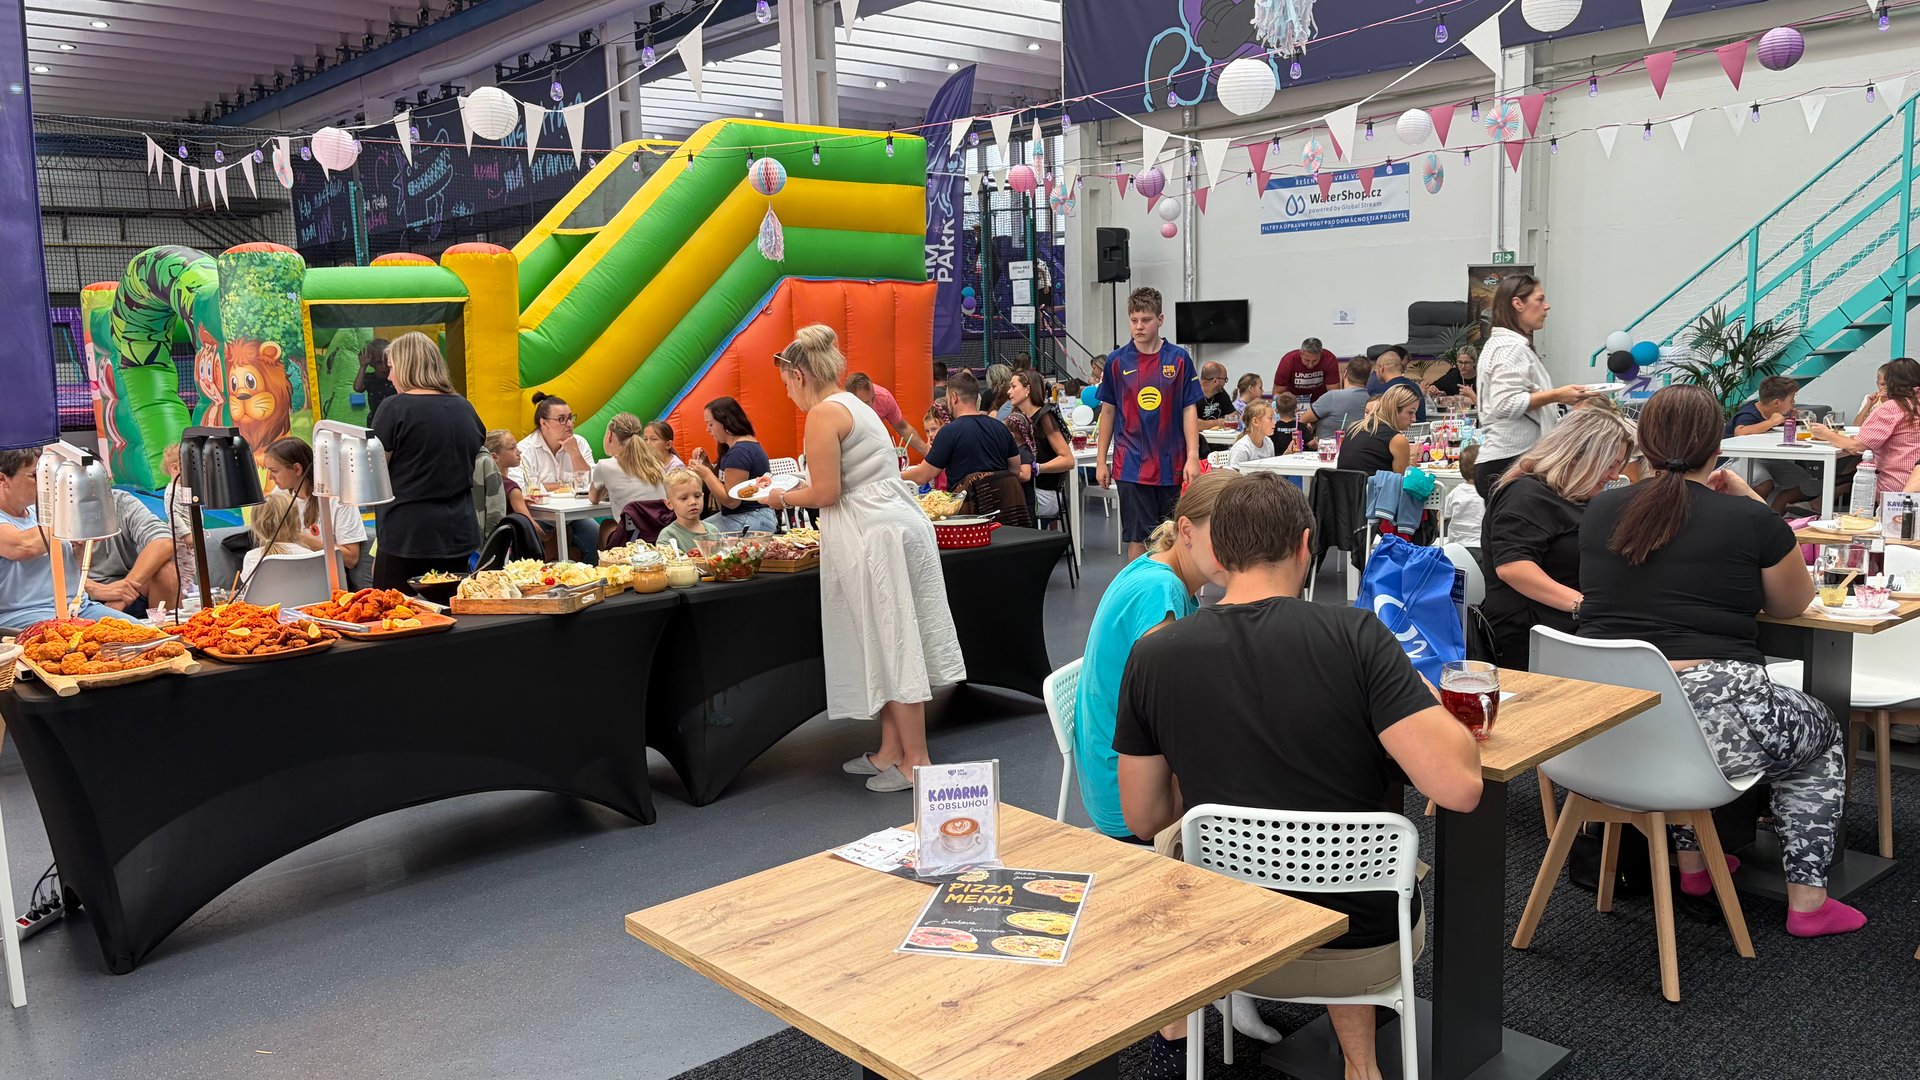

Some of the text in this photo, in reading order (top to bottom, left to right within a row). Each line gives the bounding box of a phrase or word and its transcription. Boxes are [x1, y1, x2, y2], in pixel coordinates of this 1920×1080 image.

[1308, 205, 1333, 214] powered
[1341, 202, 1360, 210] Global
[1360, 201, 1382, 209] Stream
[1380, 212, 1408, 220] PRŮMYSL
[937, 218, 955, 283] PARK
[928, 784, 988, 802] KAVÁRNA
[929, 799, 989, 811] S OBSLUHOU
[948, 882, 1014, 895] PIZZA
[944, 893, 1014, 906] MENU
